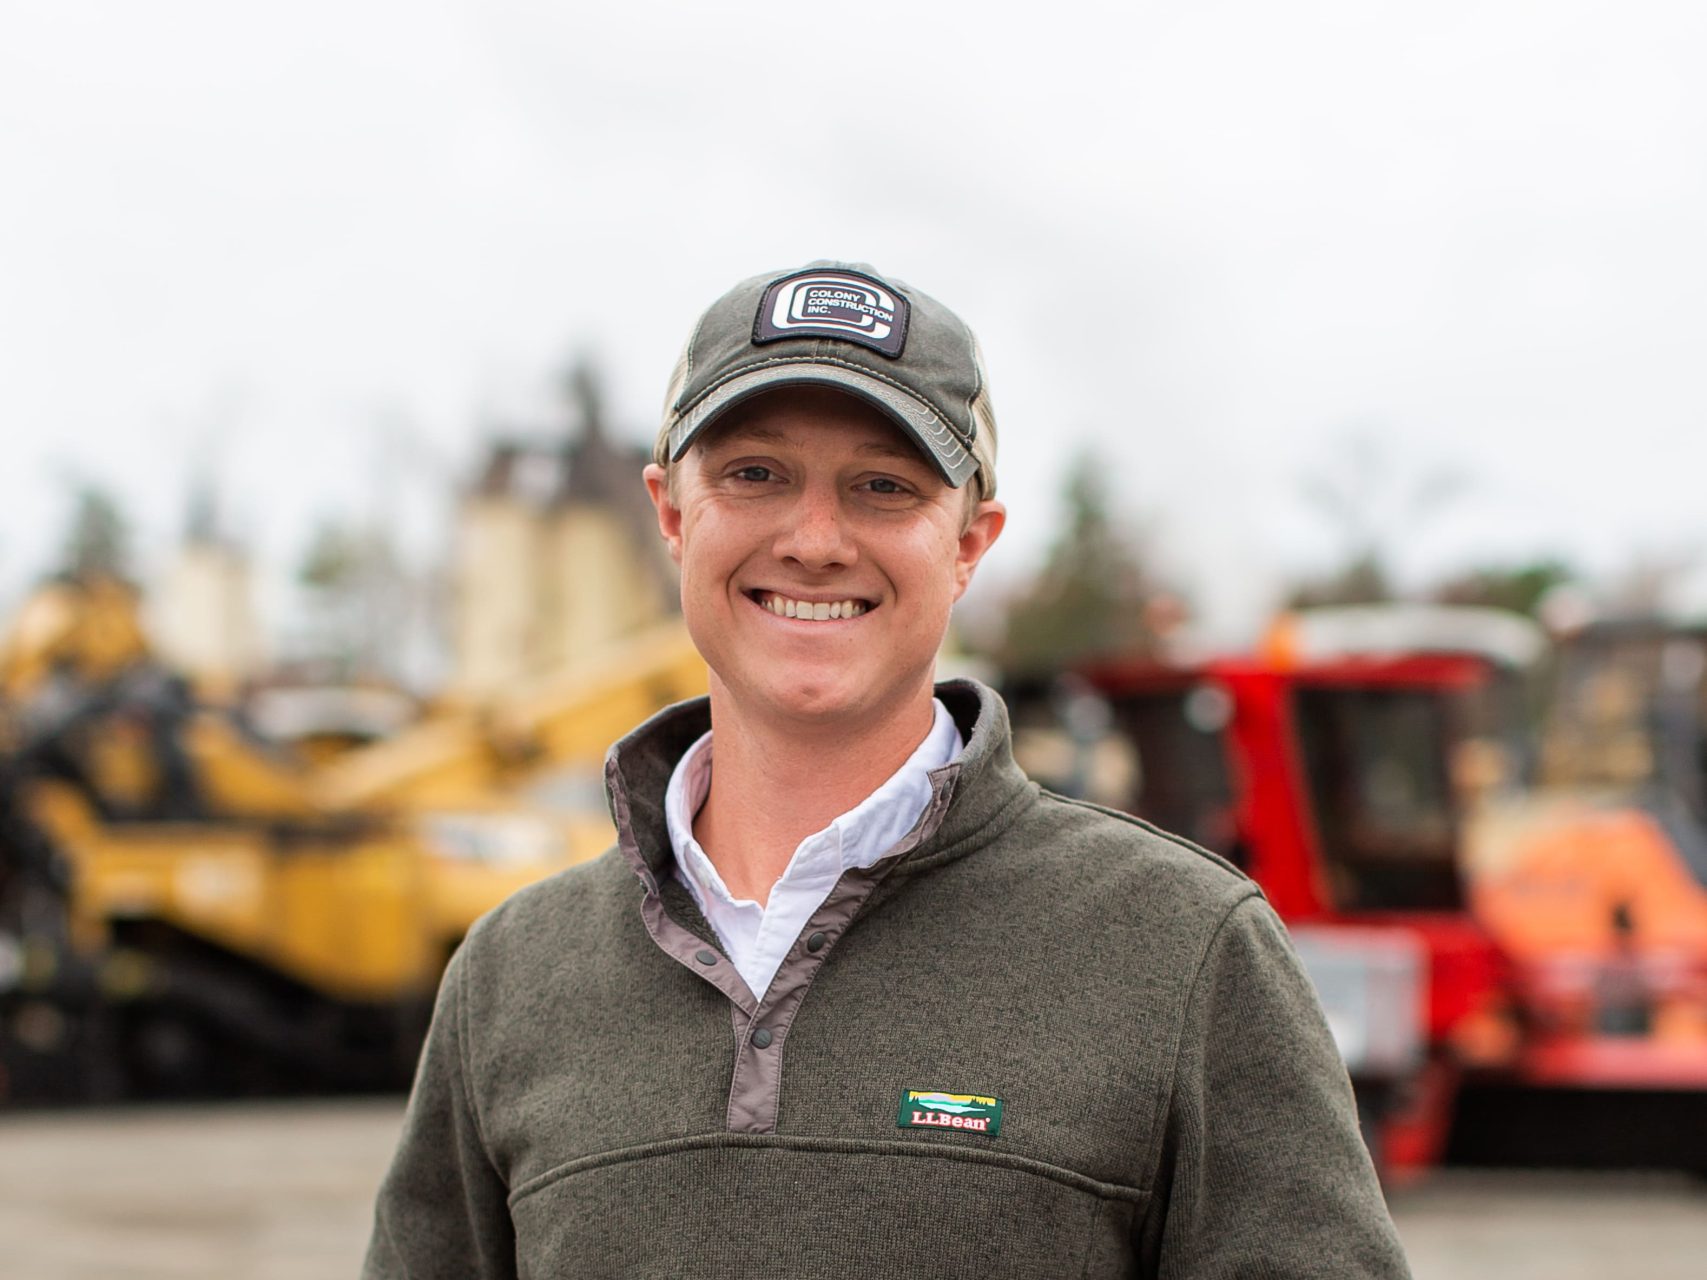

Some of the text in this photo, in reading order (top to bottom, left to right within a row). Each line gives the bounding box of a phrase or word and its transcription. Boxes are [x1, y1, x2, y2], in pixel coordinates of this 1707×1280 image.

[809, 290, 861, 302] COLONY
[807, 306, 832, 314] INC.
[808, 298, 893, 322] CONSTRUCTION
